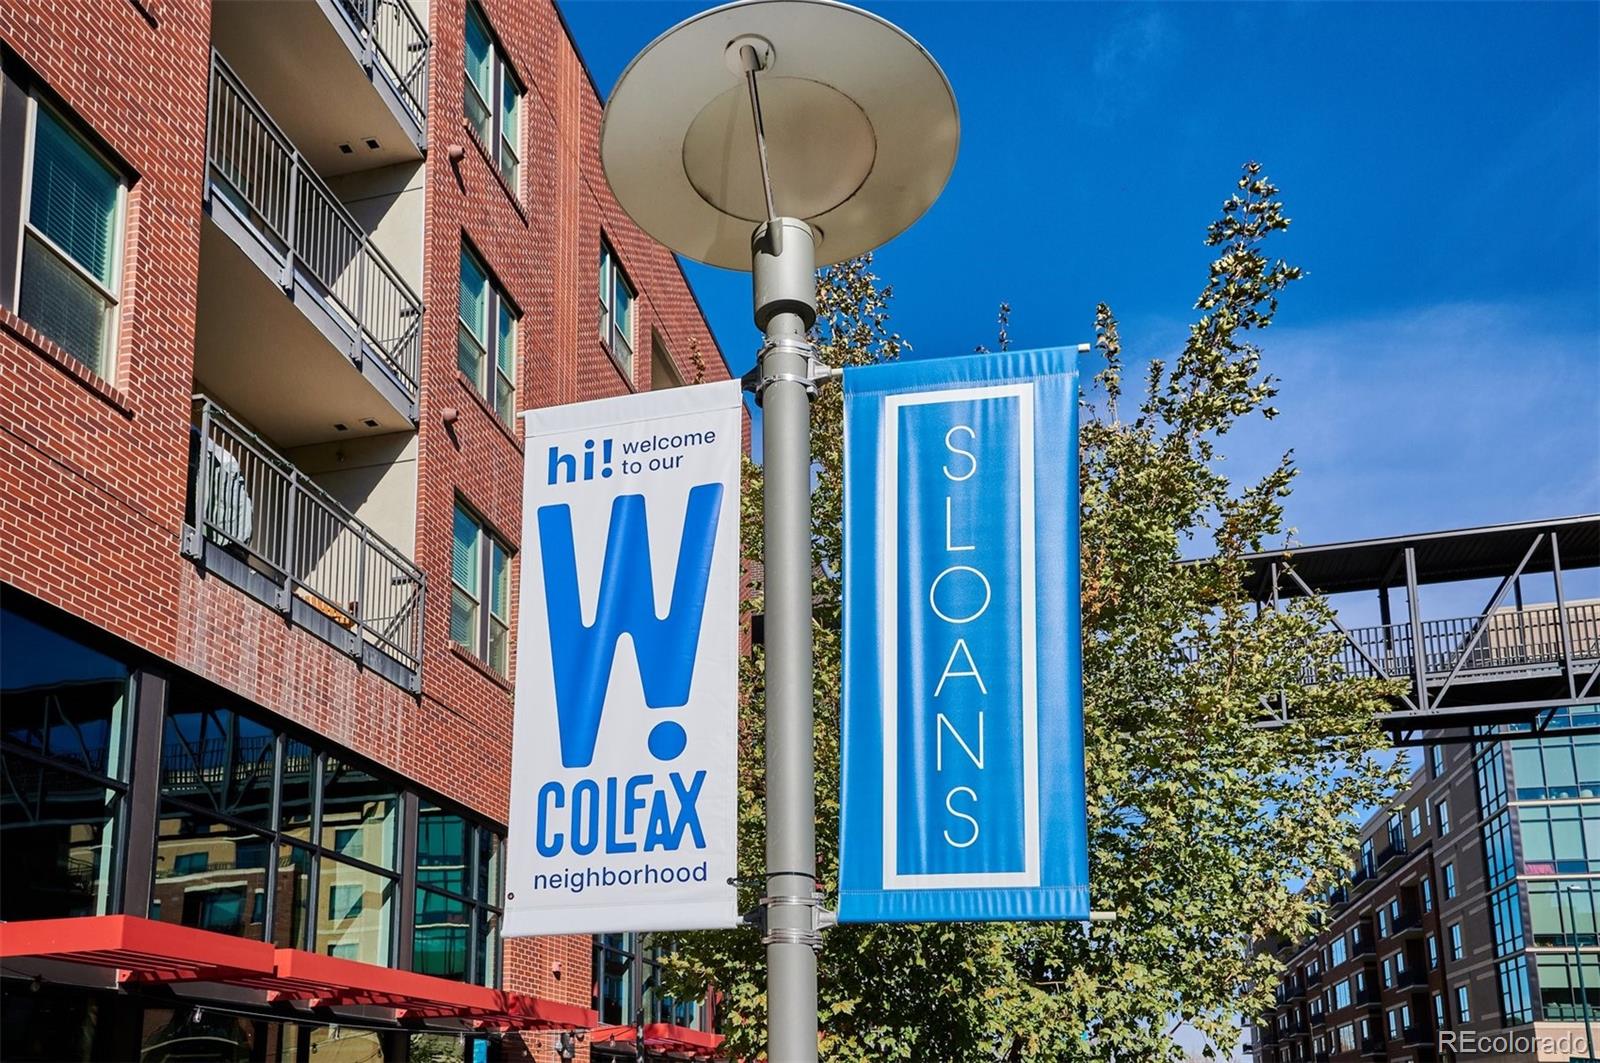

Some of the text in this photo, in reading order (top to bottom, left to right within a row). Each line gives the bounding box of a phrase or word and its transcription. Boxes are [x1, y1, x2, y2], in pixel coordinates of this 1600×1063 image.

[547, 438, 613, 485] hi!
[622, 430, 716, 455] welcome
[622, 455, 684, 475] to our
[930, 425, 991, 848] SLOANS
[536, 770, 707, 858] COLFAX
[533, 861, 708, 893] neighborhood
